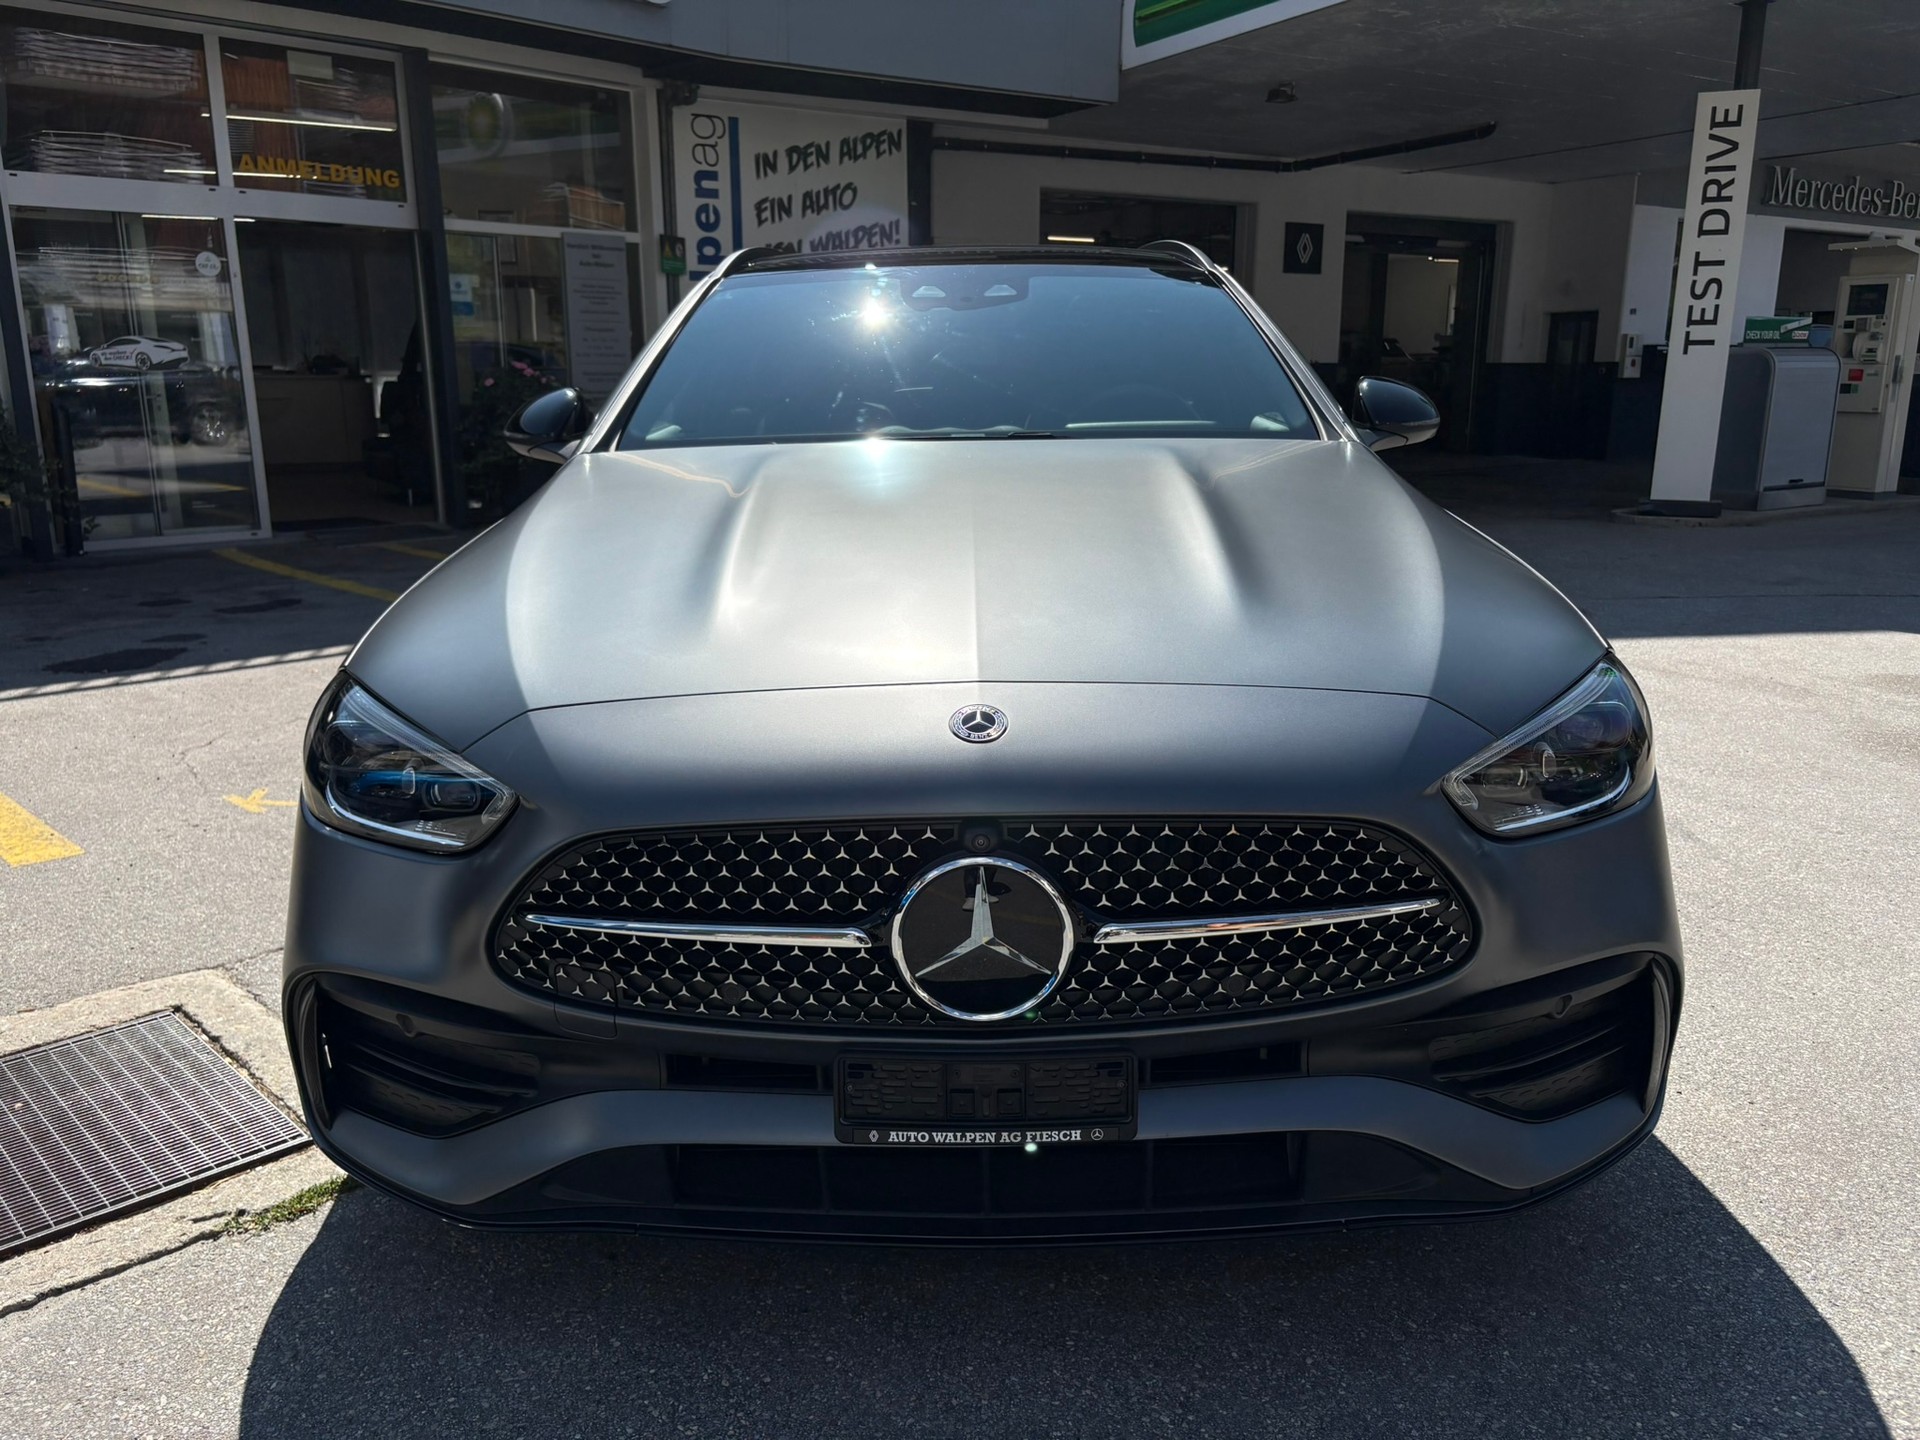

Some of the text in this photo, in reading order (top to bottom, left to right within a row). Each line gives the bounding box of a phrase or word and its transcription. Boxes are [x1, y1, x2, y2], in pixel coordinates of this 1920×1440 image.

[239, 153, 400, 188] ANMELDUNG
[754, 128, 902, 180] IN DEN ALPEN
[689, 113, 727, 281] lpenag
[754, 182, 858, 228] EIN AUTO
[1769, 165, 1920, 219] Mercedes-Be
[1682, 104, 1744, 355] TEST DRIVE
[888, 1130, 1082, 1143] AUTO WALPEN AG FIESCH
